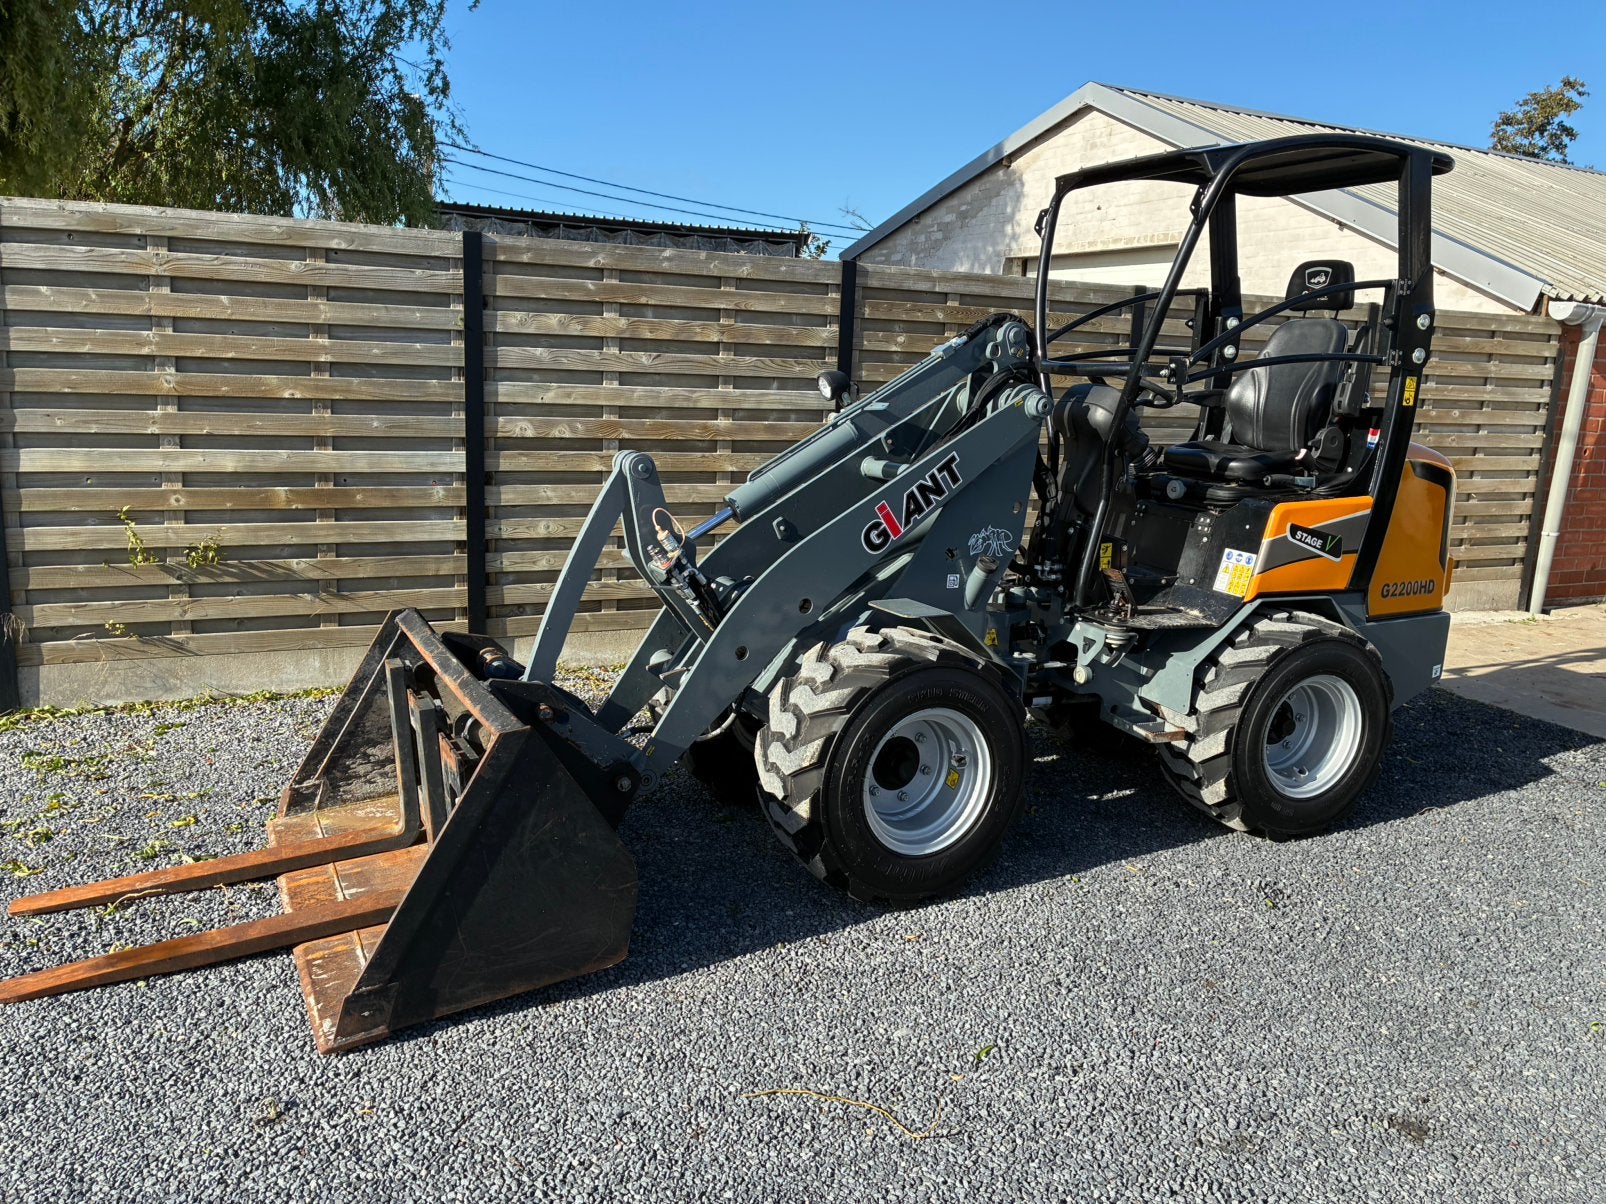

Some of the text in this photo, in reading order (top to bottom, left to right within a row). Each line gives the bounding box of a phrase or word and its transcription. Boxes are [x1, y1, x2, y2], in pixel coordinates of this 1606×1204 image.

[862, 452, 962, 554] GIANT
[1296, 531, 1341, 551] STAGE V
[1382, 580, 1435, 598] G2200HD
